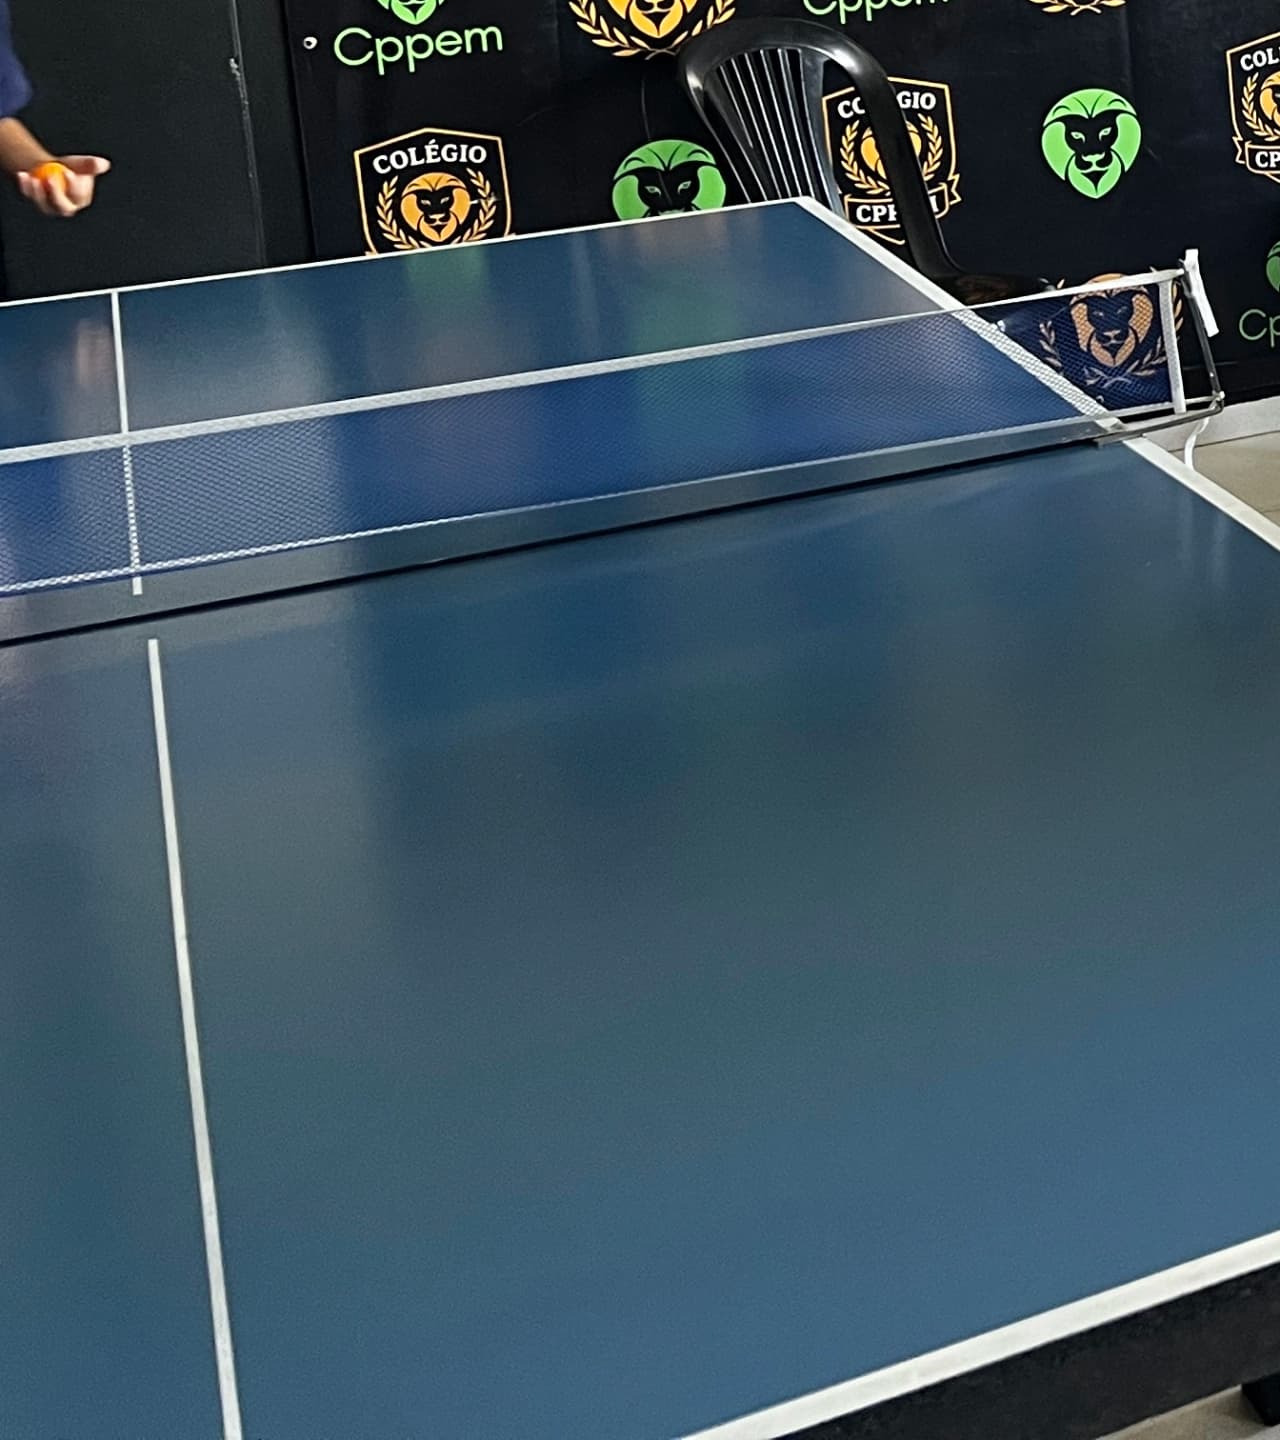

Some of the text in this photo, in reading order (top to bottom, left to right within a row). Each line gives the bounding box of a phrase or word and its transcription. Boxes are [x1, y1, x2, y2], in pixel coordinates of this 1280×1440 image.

[333, 24, 504, 76] Cppem
[837, 90, 937, 119] COGIO
[372, 138, 488, 176] COLÉGIO
